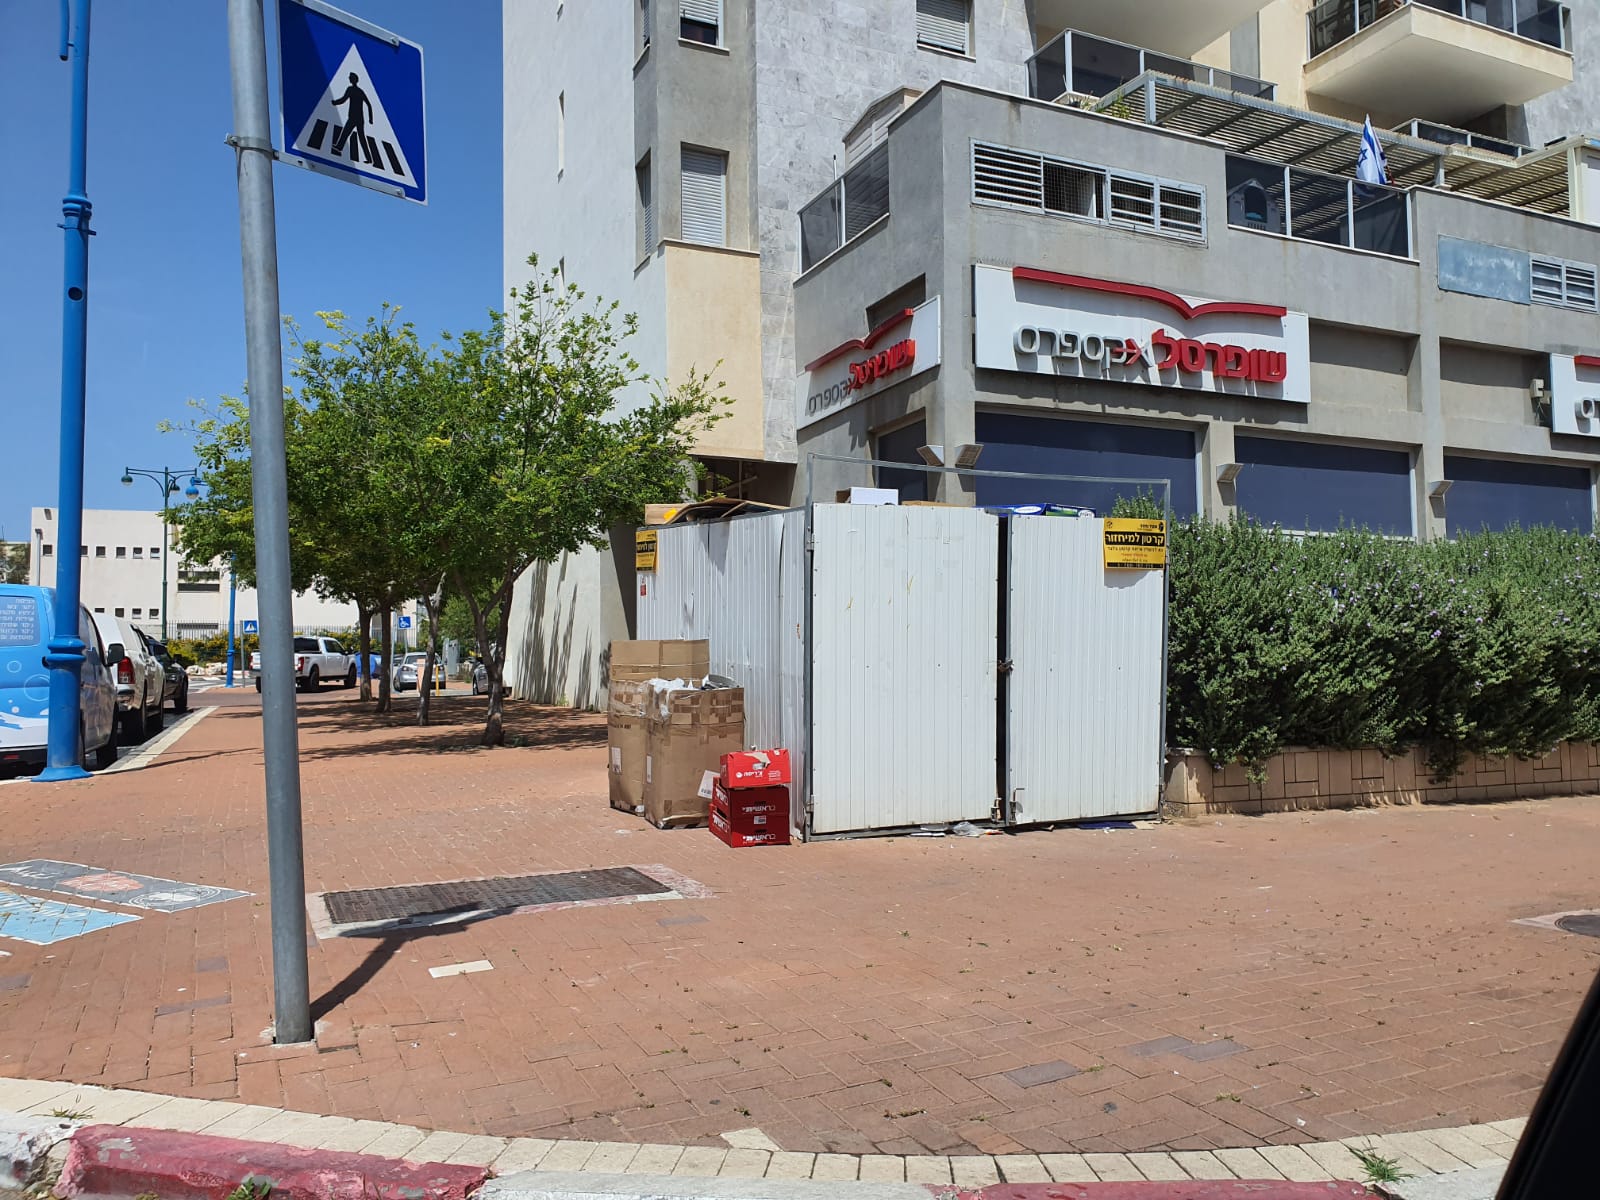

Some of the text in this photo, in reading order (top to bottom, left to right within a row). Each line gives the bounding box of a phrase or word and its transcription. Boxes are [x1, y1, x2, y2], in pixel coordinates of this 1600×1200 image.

[849, 339, 917, 390] שופרסל
[1151, 328, 1288, 384] שופרסל
[1105, 532, 1164, 545] קרטון למיחזור
